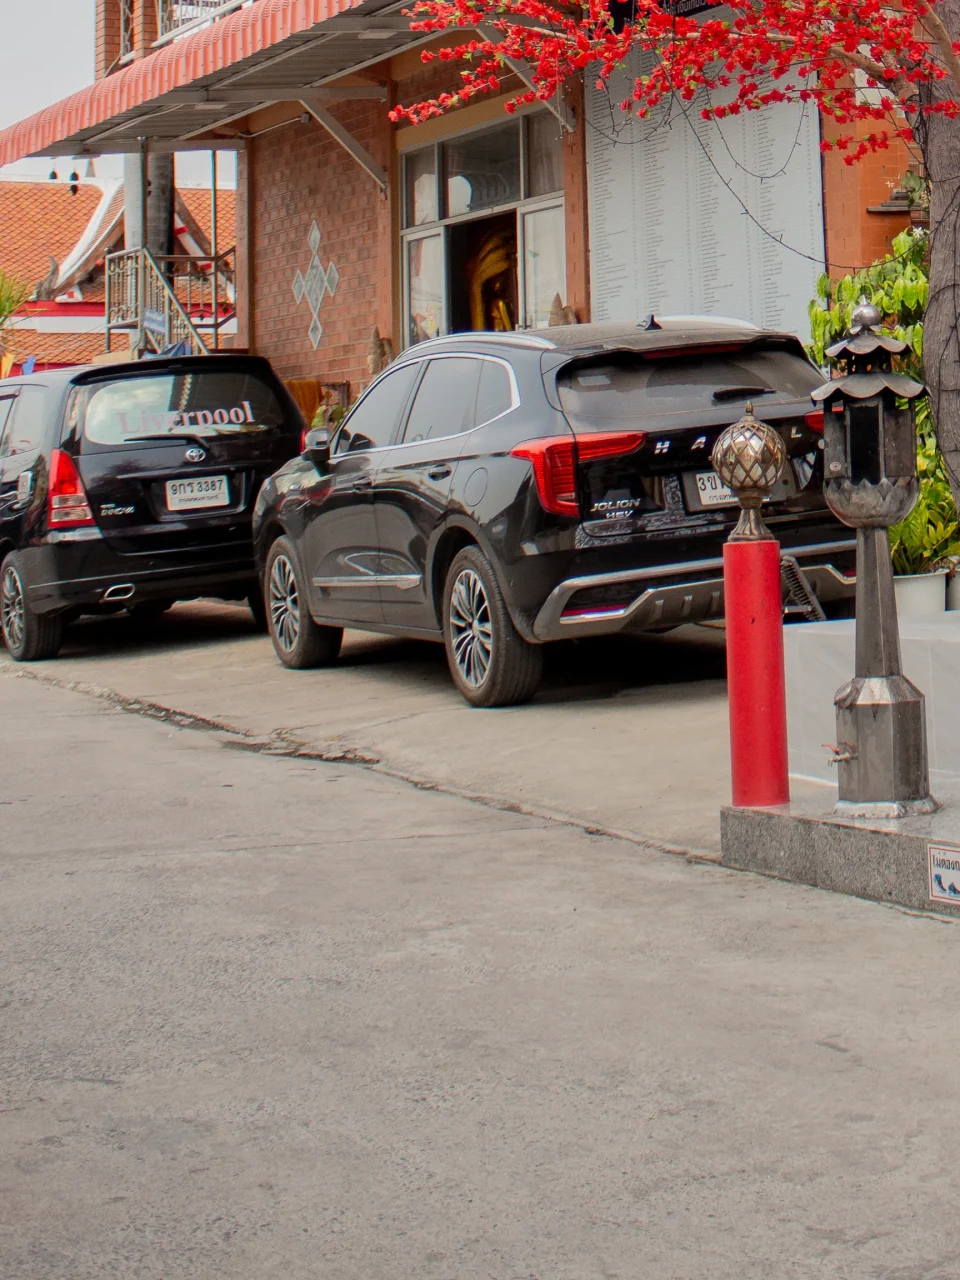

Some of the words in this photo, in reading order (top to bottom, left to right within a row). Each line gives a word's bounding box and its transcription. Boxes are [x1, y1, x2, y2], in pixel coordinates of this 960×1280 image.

[116, 400, 256, 435] Liverpool
[653, 426, 802, 455] HAL
[196, 479, 224, 493] 3387
[698, 474, 725, 492] 3ข
[590, 498, 642, 513] JOLION
[605, 510, 633, 520] HEV
